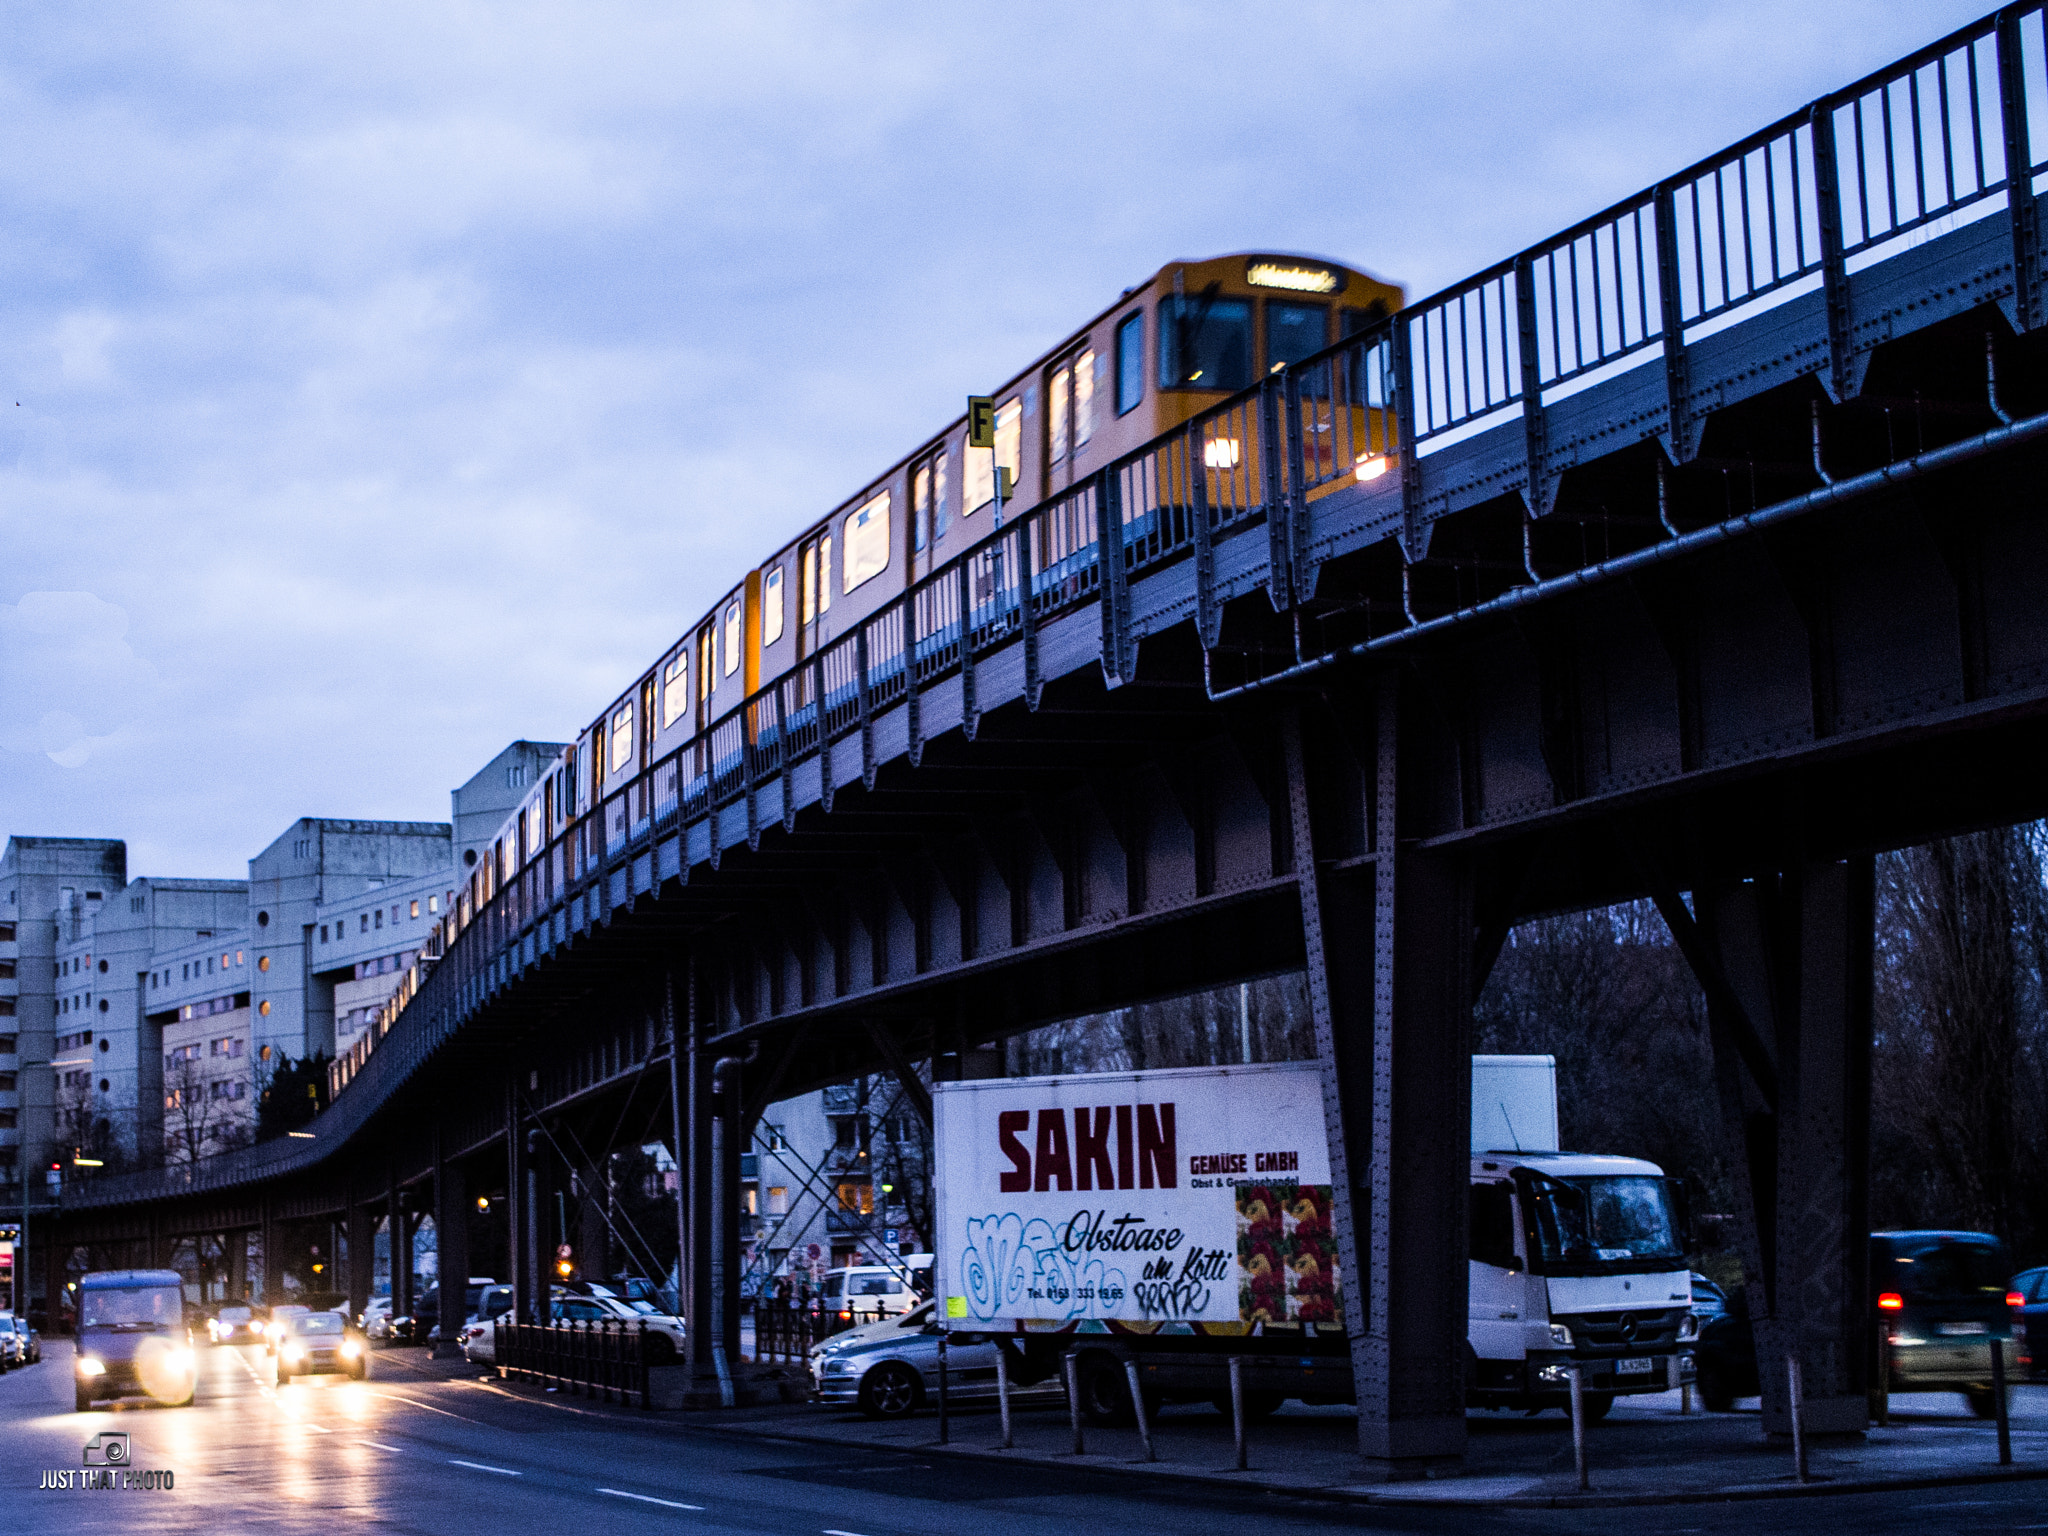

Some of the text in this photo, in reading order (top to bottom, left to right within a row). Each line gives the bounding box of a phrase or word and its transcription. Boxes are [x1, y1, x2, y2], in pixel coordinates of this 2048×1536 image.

[973, 402, 991, 440] F
[998, 1102, 1177, 1192] SAKIN
[1190, 1151, 1299, 1175] GEMÜSE GMBH
[1191, 1178, 1213, 1189] Obst
[1064, 1209, 1185, 1252] Obstoase
[1142, 1246, 1233, 1281] am Kotti
[1077, 1287, 1095, 1299] 333
